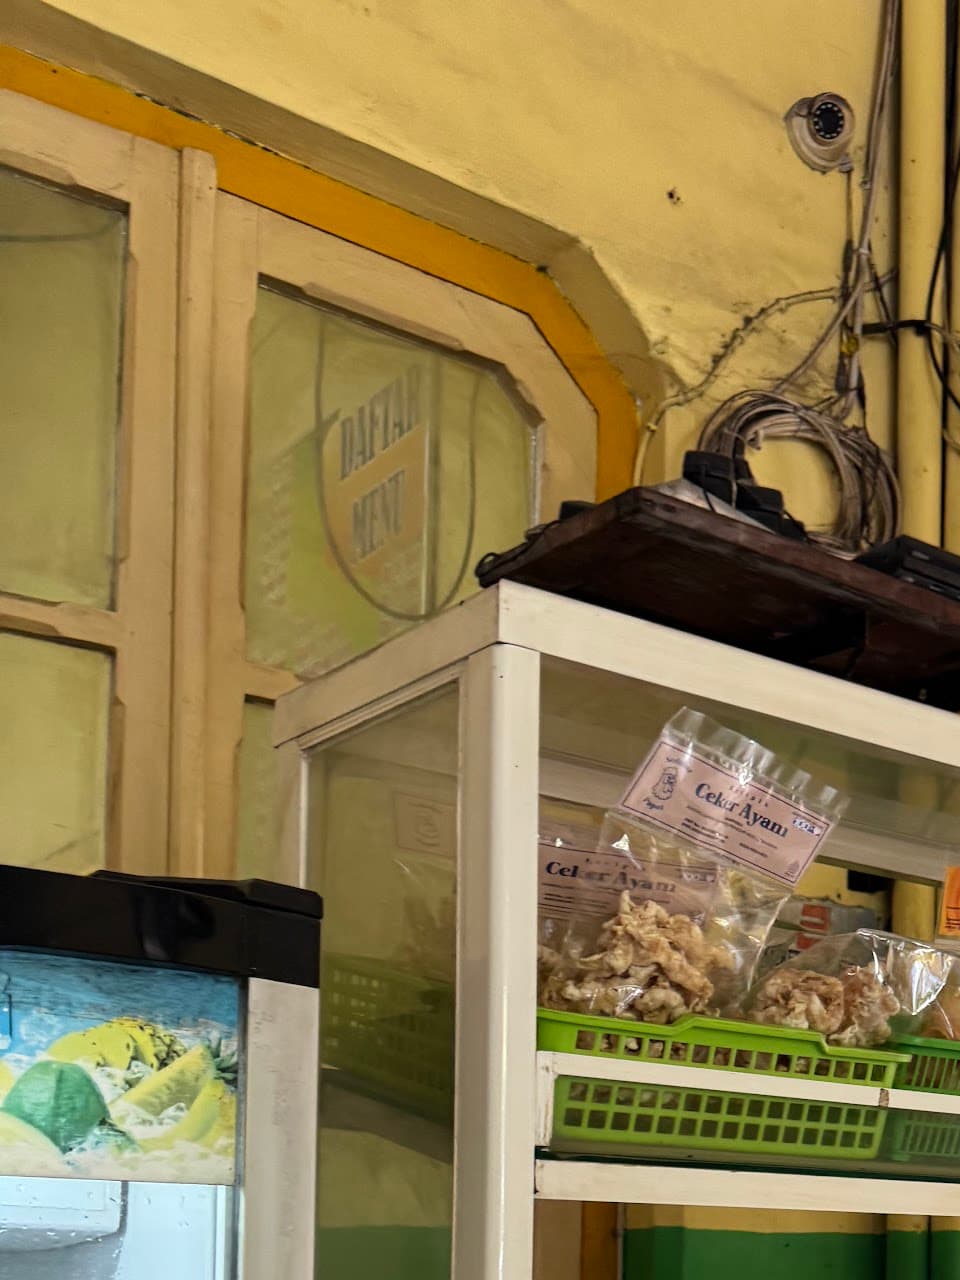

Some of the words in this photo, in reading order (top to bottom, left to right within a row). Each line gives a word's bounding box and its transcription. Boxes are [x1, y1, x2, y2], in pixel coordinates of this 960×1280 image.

[341, 364, 422, 481] DAFTAR
[695, 783, 739, 812] Ceker
[739, 801, 788, 838] Ayam
[545, 861, 611, 882] Ceer
[614, 871, 676, 892] Ayam
